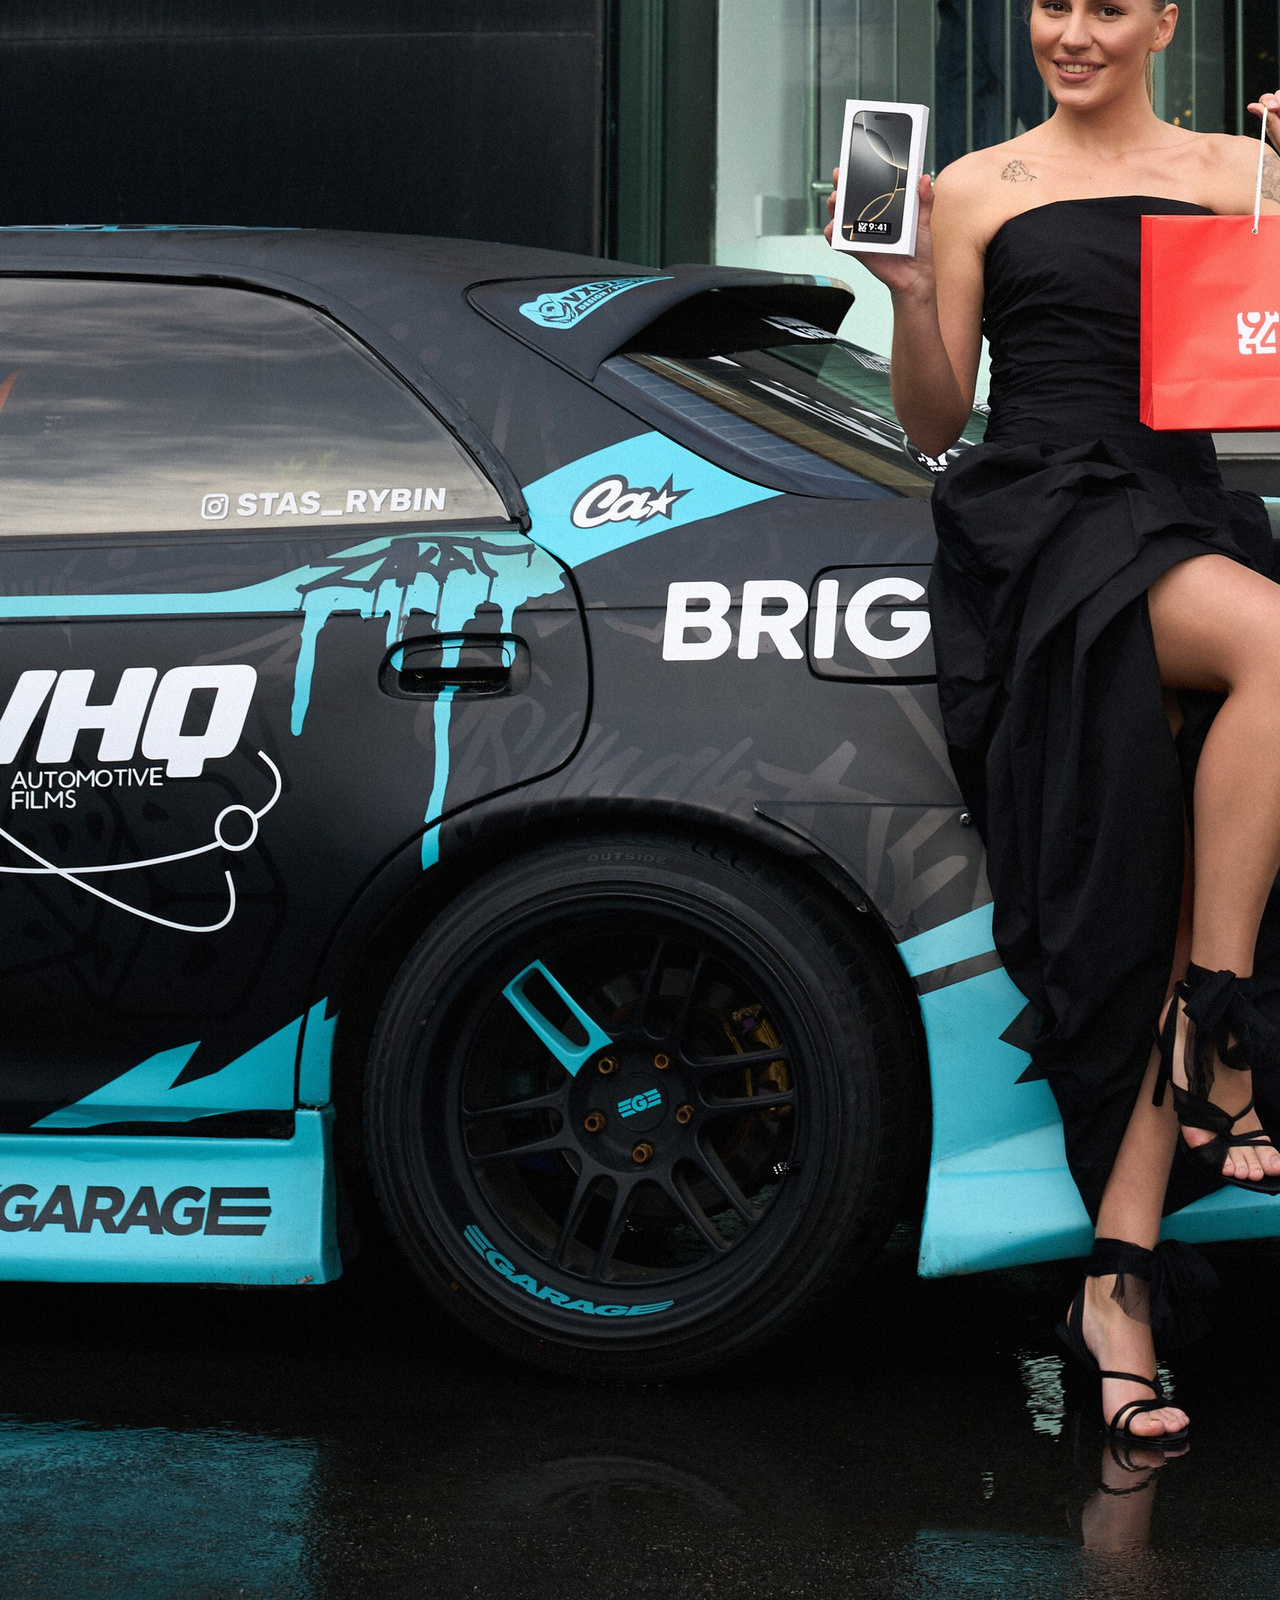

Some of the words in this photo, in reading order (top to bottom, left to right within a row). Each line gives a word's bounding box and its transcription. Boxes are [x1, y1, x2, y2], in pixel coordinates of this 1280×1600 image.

[868, 222, 887, 232] 9:41
[236, 487, 447, 517] STAS_RYBIN
[662, 577, 932, 661] BRIG
[11, 767, 164, 789] AUTOMOTIVE
[11, 789, 77, 810] FILMS
[587, 852, 668, 865] OUTSIDE
